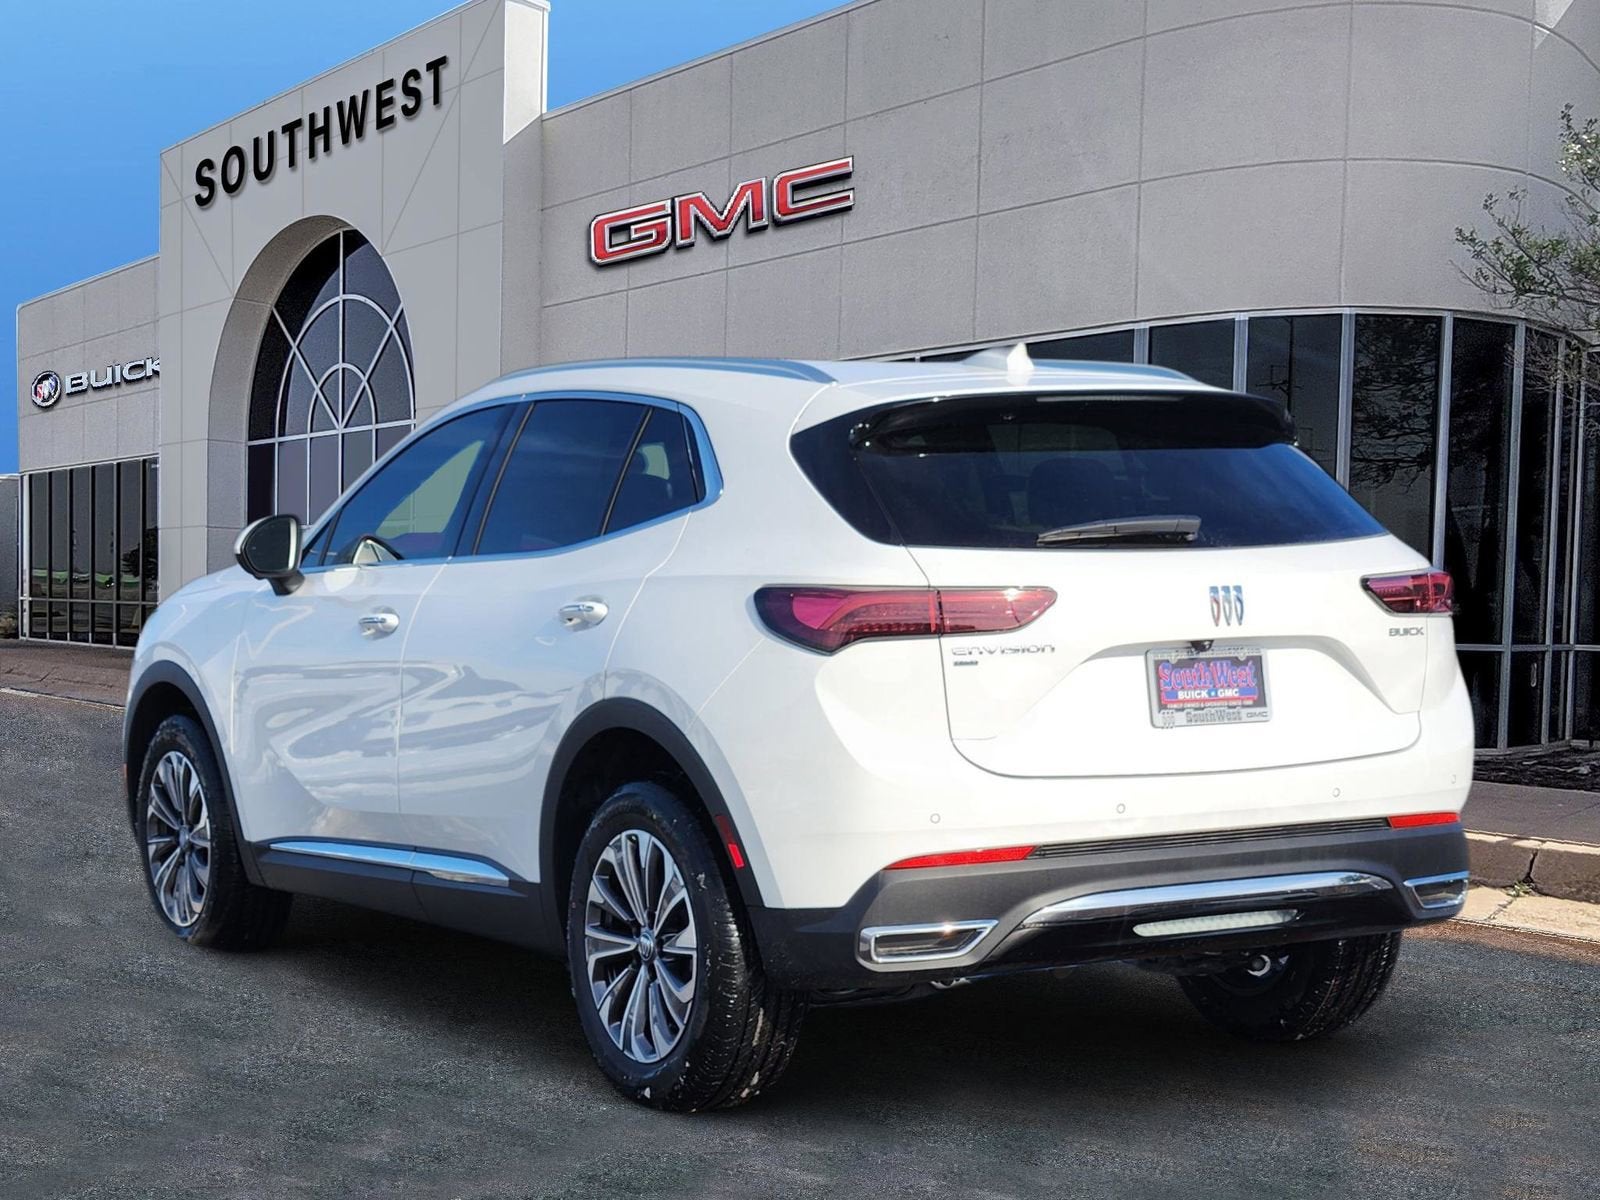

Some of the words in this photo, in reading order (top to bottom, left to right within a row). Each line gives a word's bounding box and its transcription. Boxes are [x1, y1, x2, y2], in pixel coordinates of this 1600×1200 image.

[195, 55, 448, 208] SOUTHWEST
[589, 155, 855, 265] GMC
[1389, 626, 1424, 637] BUICK
[1178, 689, 1209, 700] BUICK
[1217, 687, 1239, 698] GMC
[1246, 711, 1269, 719] GMC
